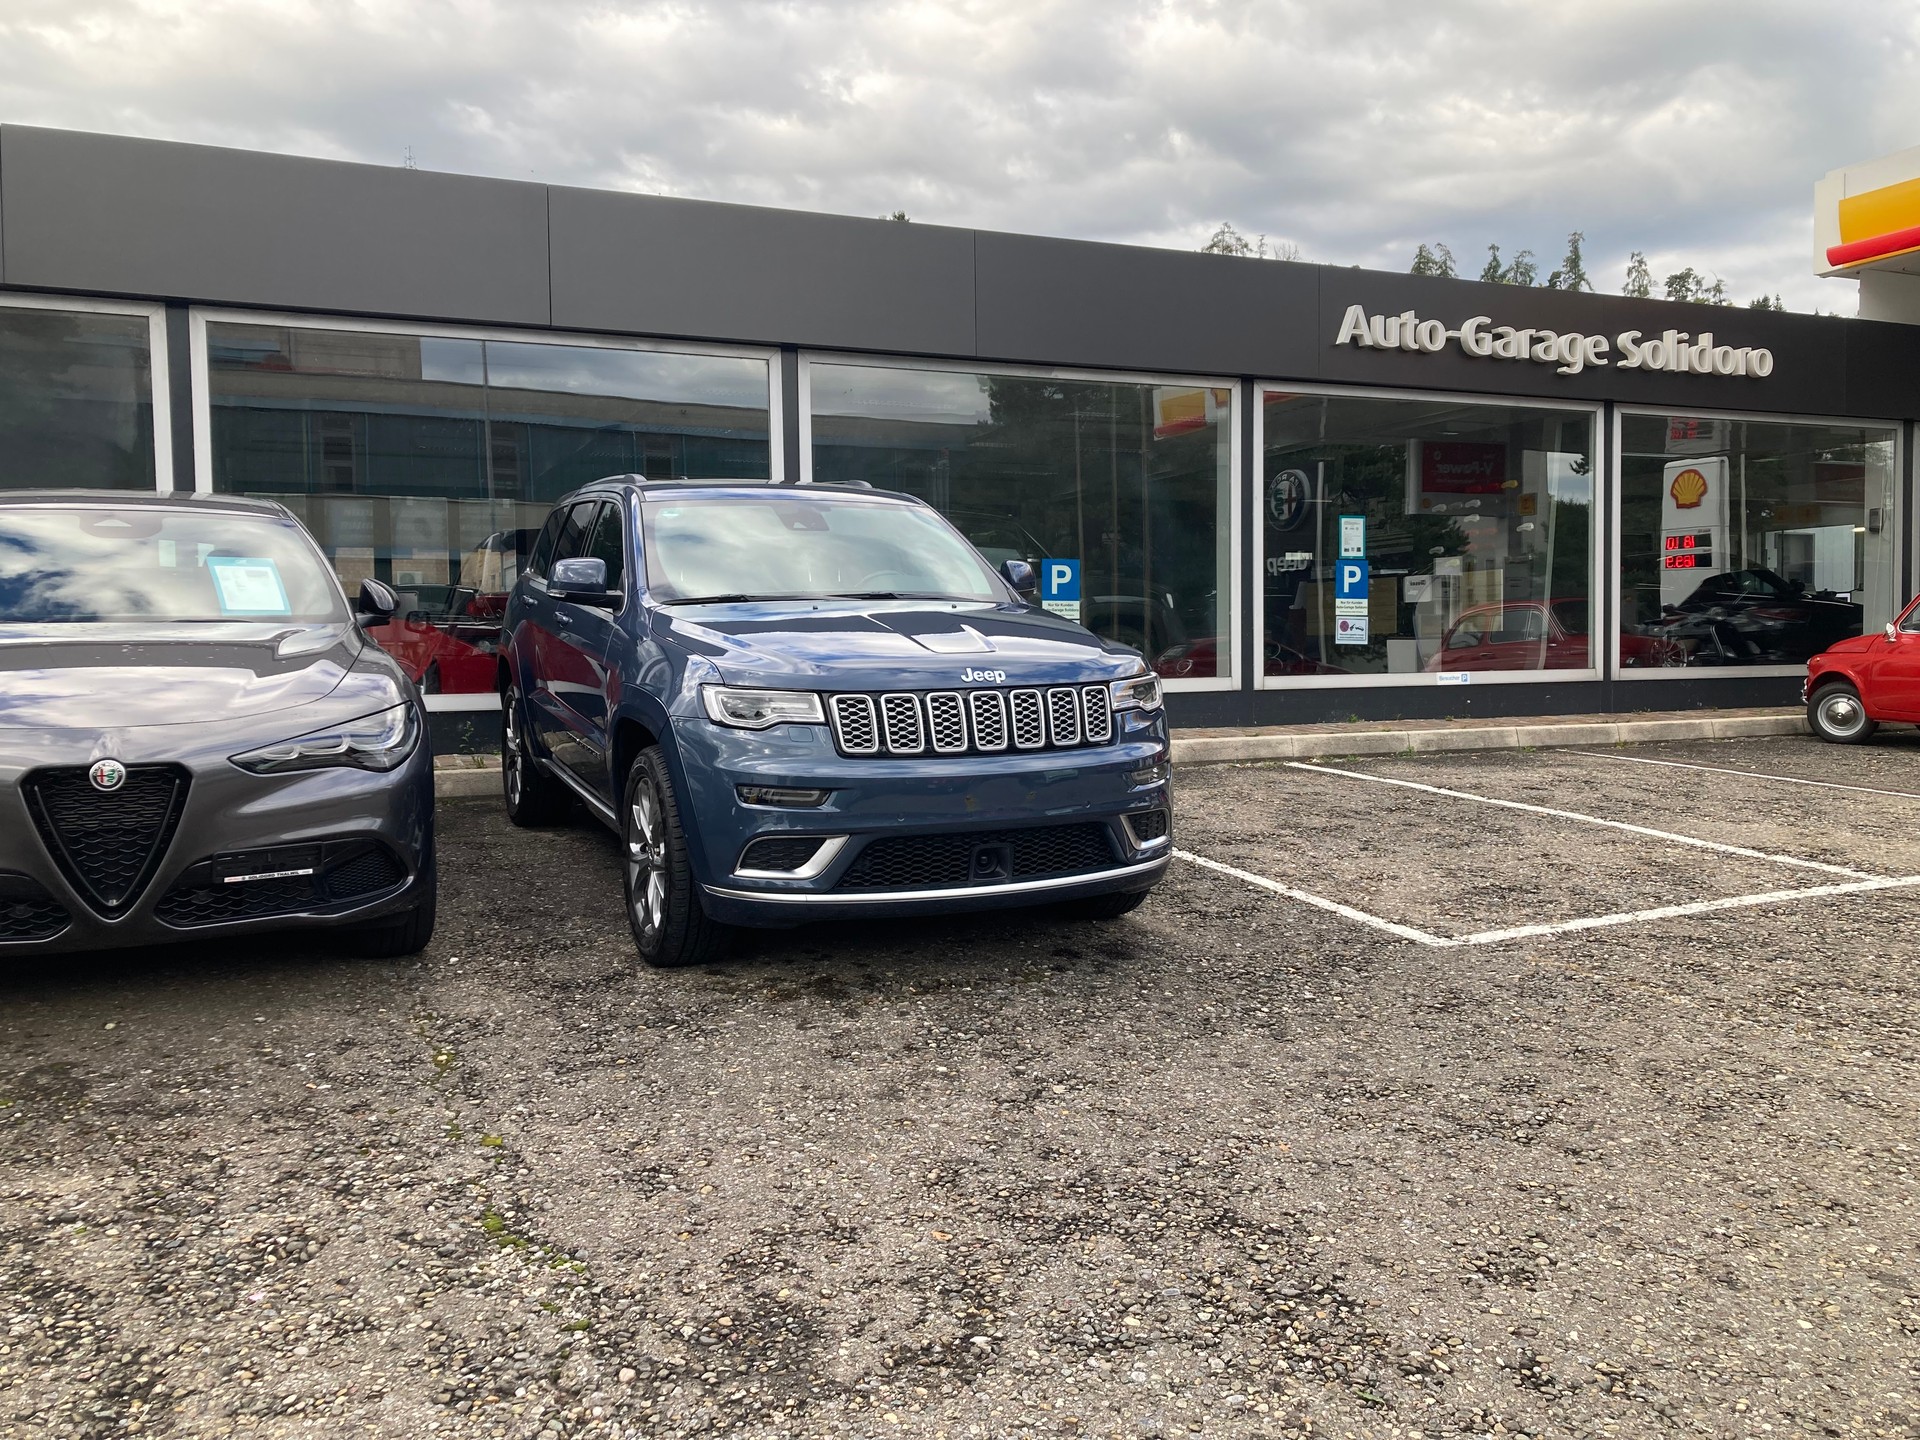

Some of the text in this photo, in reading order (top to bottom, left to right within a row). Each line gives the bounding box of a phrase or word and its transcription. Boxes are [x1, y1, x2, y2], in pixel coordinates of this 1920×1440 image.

[1335, 304, 1774, 378] Auto-Garage Solidoro
[1051, 564, 1072, 595] P
[1343, 565, 1362, 593] P
[960, 667, 1006, 684] Jeep
